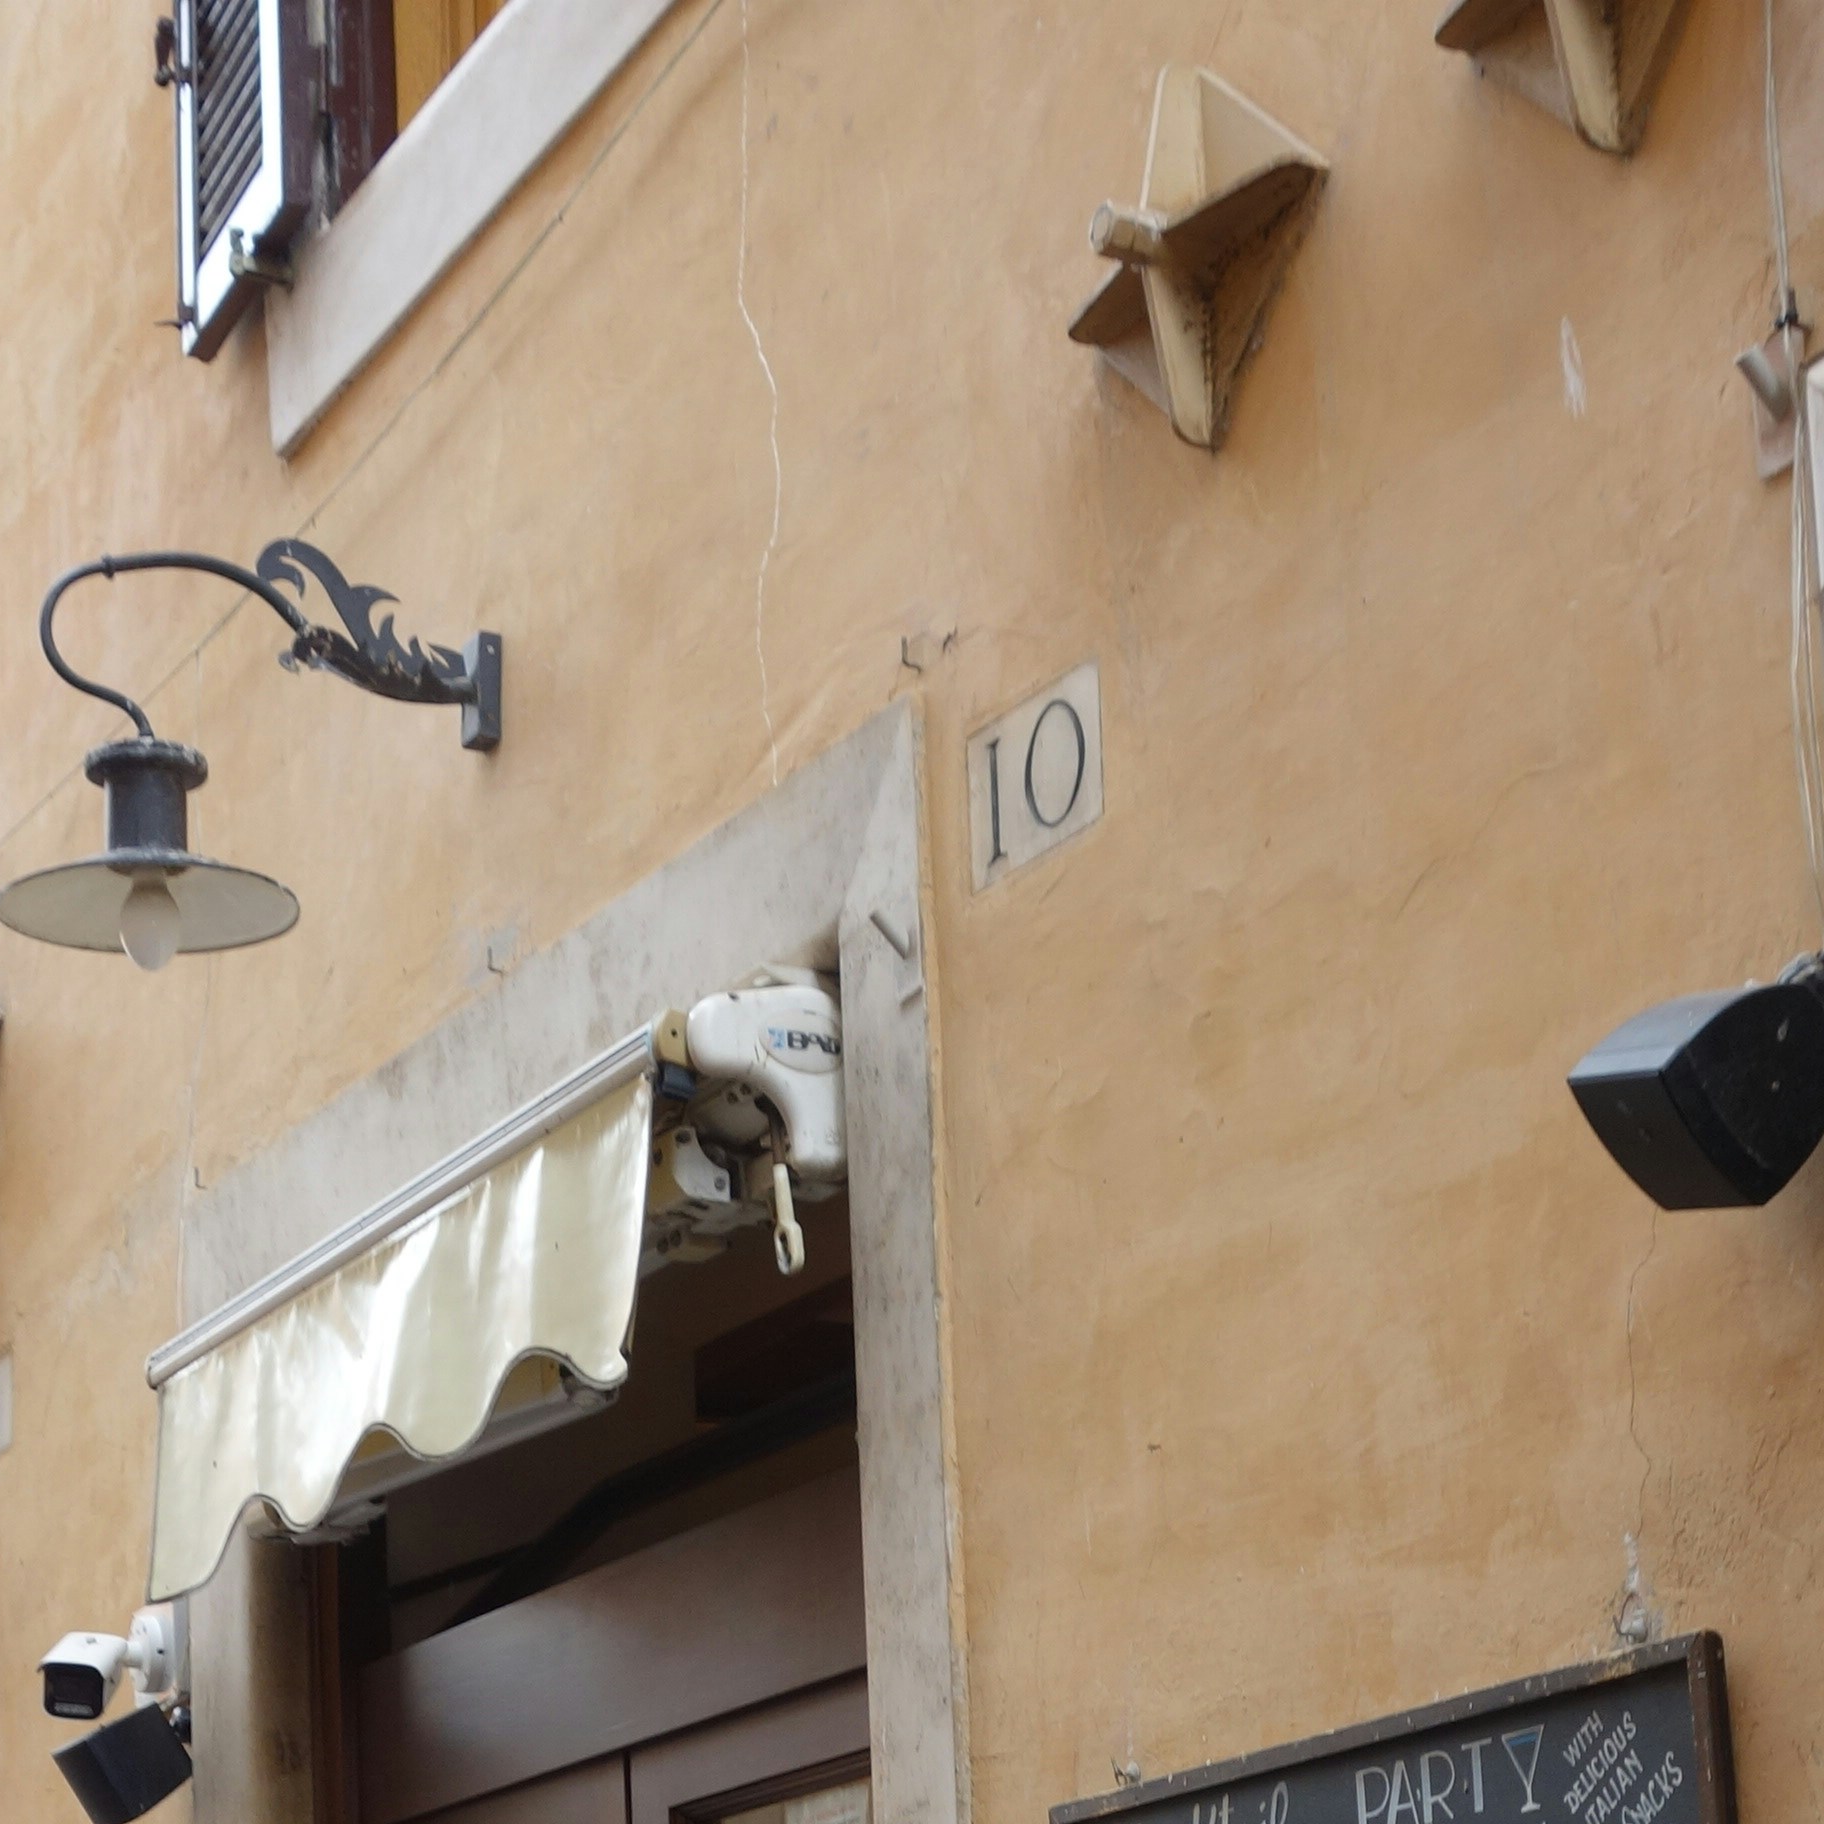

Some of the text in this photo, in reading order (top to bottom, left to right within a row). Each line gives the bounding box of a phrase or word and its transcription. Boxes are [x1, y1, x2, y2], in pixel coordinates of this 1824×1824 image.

[985, 698, 1086, 867] 10
[1563, 1710, 1604, 1767] WITH
[1564, 1711, 1637, 1815] DELICIOUS
